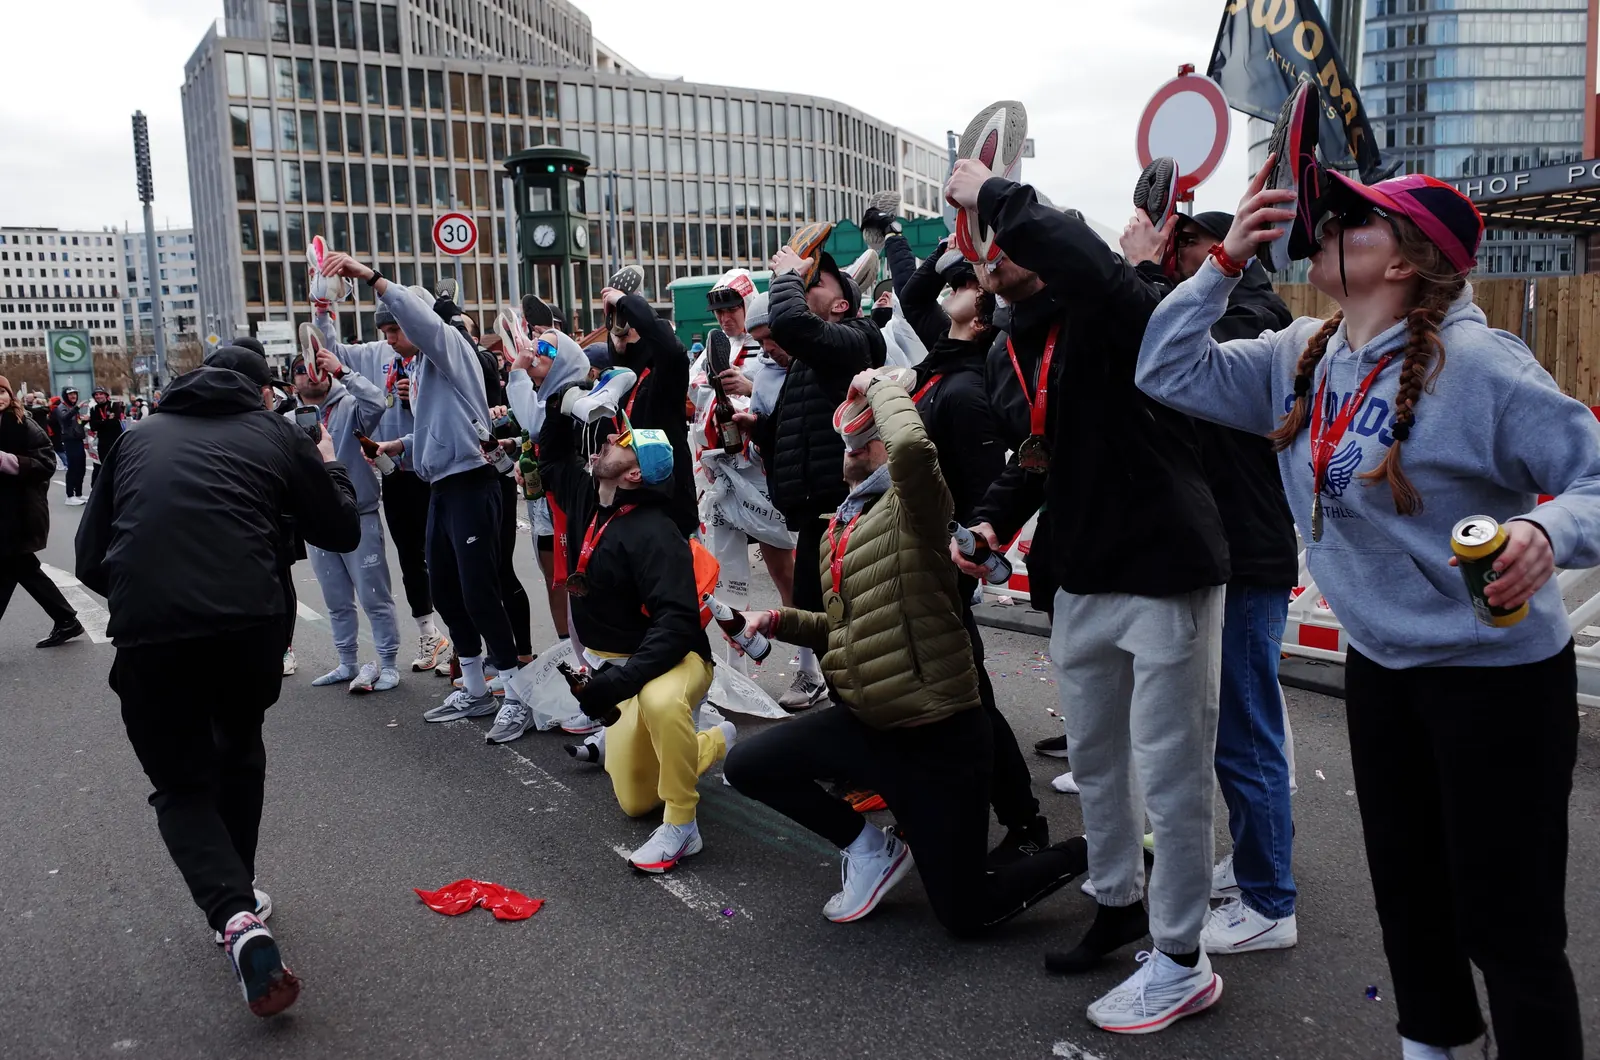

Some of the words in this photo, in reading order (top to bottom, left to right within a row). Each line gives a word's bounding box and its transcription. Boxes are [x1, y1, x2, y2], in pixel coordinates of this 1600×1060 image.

[1455, 172, 1531, 199] HOF
[443, 224, 468, 243] 30
[58, 336, 82, 362] S
